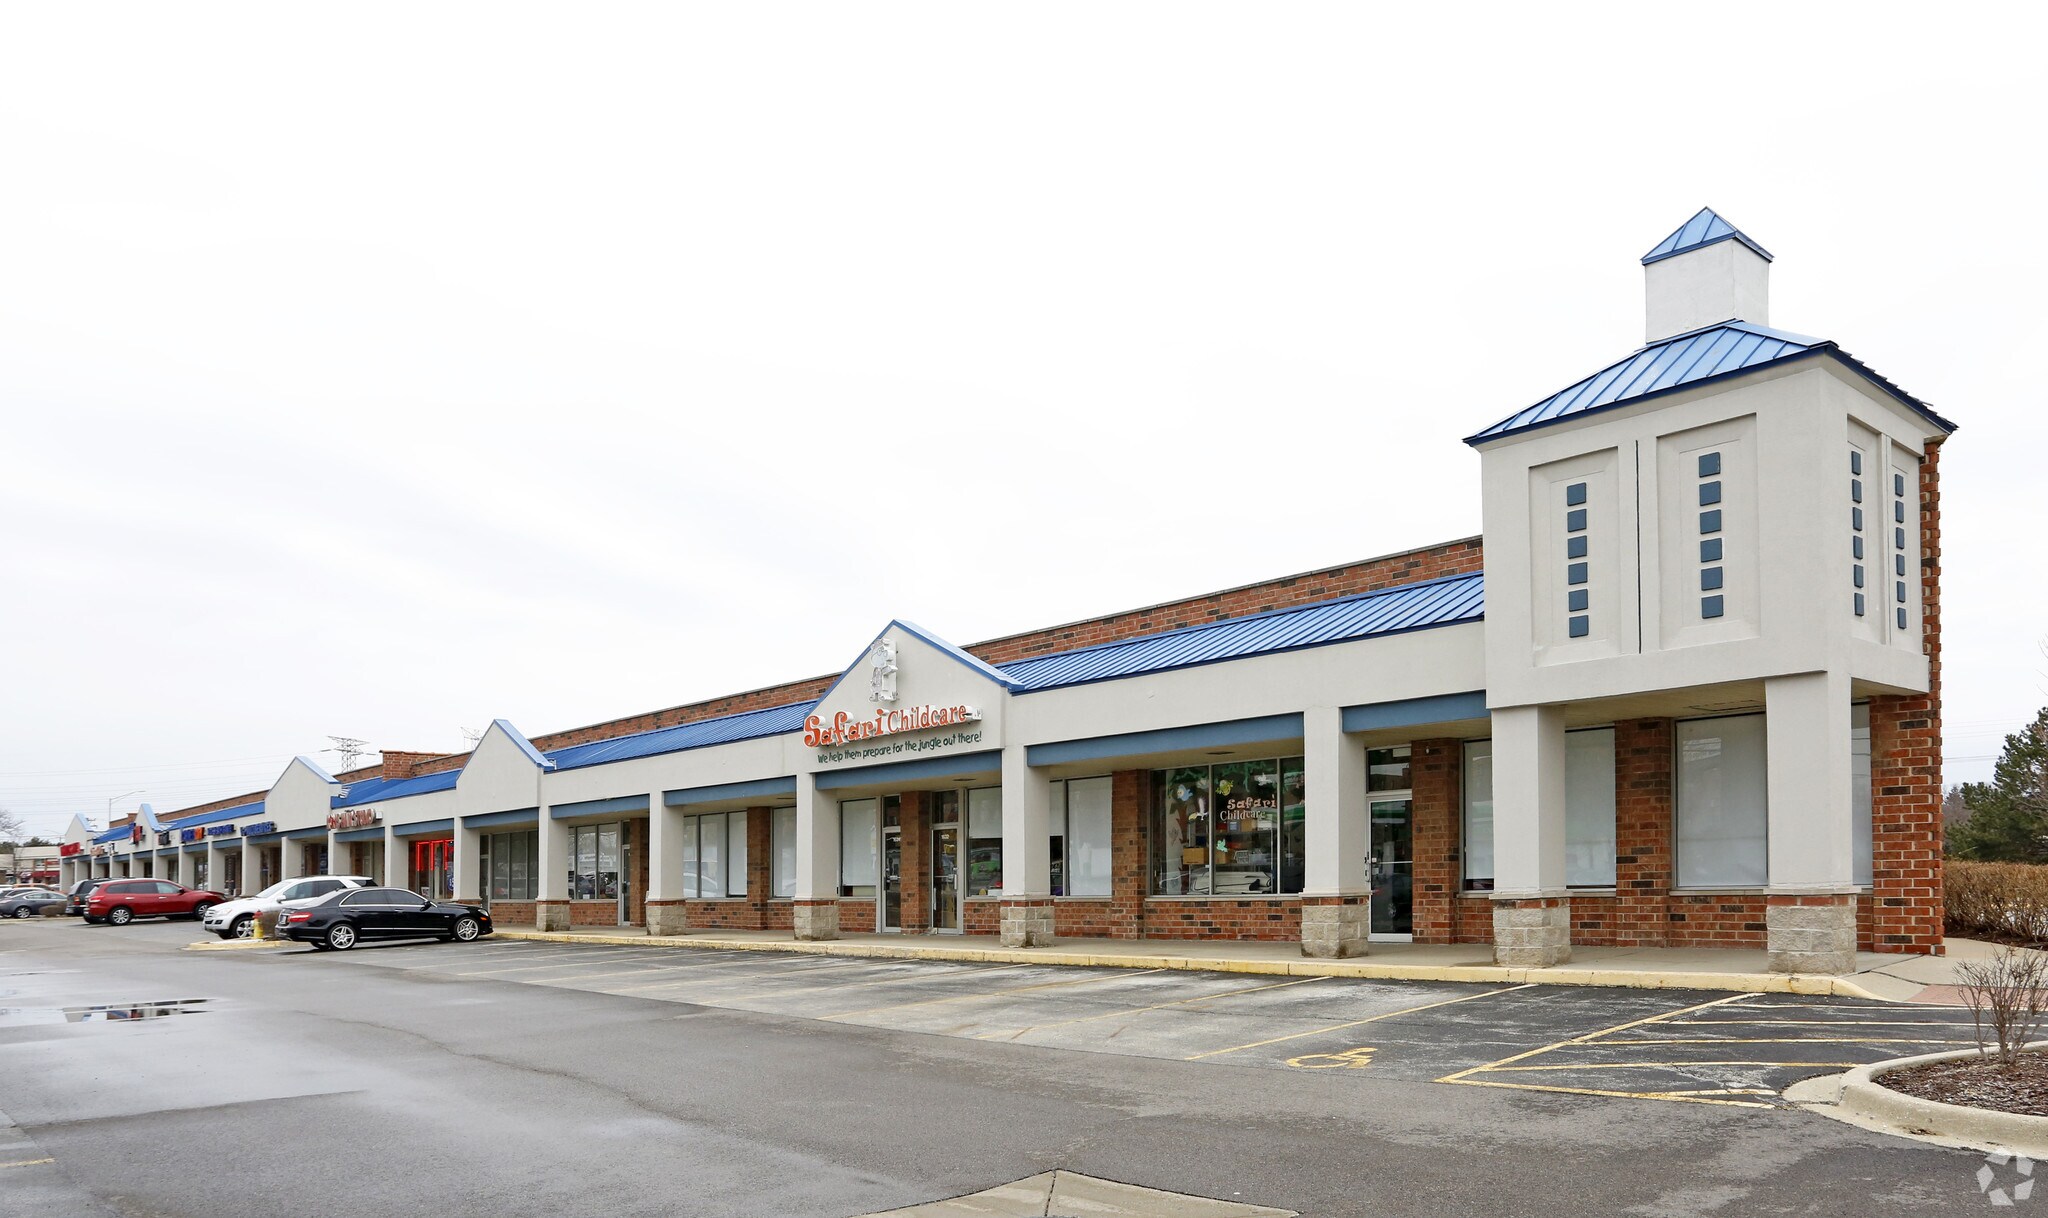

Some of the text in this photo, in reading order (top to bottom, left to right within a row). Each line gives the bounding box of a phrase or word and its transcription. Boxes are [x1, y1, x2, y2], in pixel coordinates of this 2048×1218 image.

[804, 705, 968, 747] Safari Childcare
[817, 731, 982, 764] We help them prepare for the jungle out there!
[1227, 794, 1276, 809] Safari
[1220, 809, 1266, 822] Childcare
